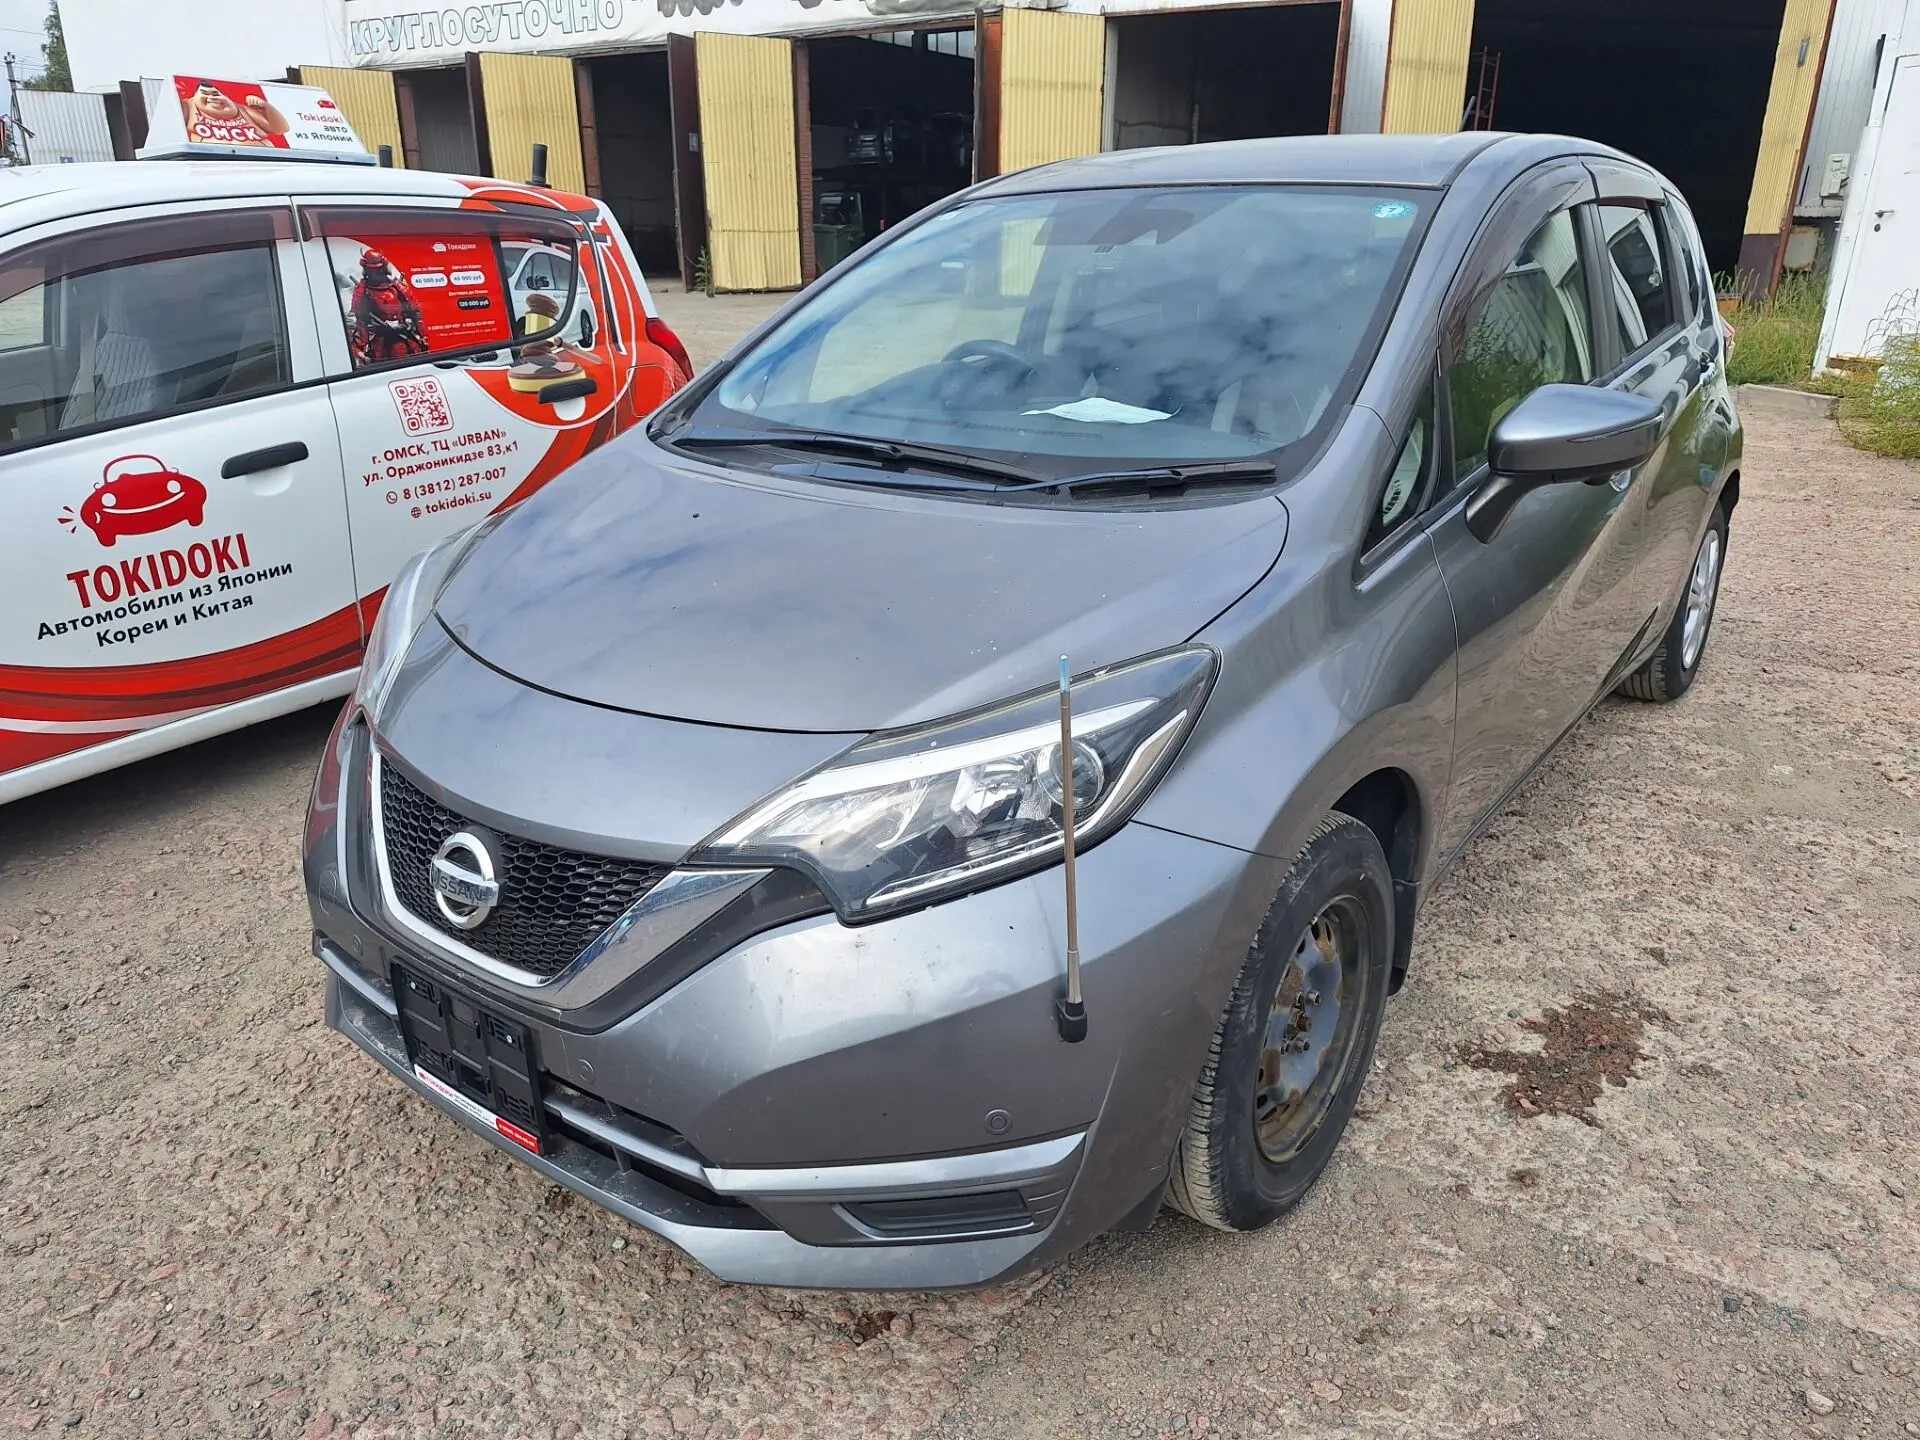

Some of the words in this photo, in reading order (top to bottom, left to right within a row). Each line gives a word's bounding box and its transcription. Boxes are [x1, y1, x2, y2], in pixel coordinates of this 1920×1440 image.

[351, 0, 623, 55] КРУГЛОСУТОЧНО
[194, 124, 263, 142] ОМСК
[296, 112, 343, 123] Tokidoki
[323, 125, 347, 133] авто
[311, 132, 353, 142] Японии
[371, 456, 382, 465] г.
[383, 443, 430, 462] ОМСК,
[431, 440, 450, 453] ТЦ
[452, 428, 507, 448] «URBAN»
[362, 471, 384, 486] ул.
[386, 450, 485, 479] Орджоникидзе
[403, 488, 412, 500] 8
[414, 479, 456, 499] (3812)
[459, 467, 506, 487] 287-007
[425, 491, 492, 514] tokidoki.su
[66, 533, 250, 608] TOKIDOKI
[37, 591, 184, 640] Автомобили
[189, 584, 213, 599] из
[217, 563, 293, 592] Японии
[96, 618, 169, 647] Кореи
[175, 610, 188, 626] и
[192, 595, 254, 621] Китая
